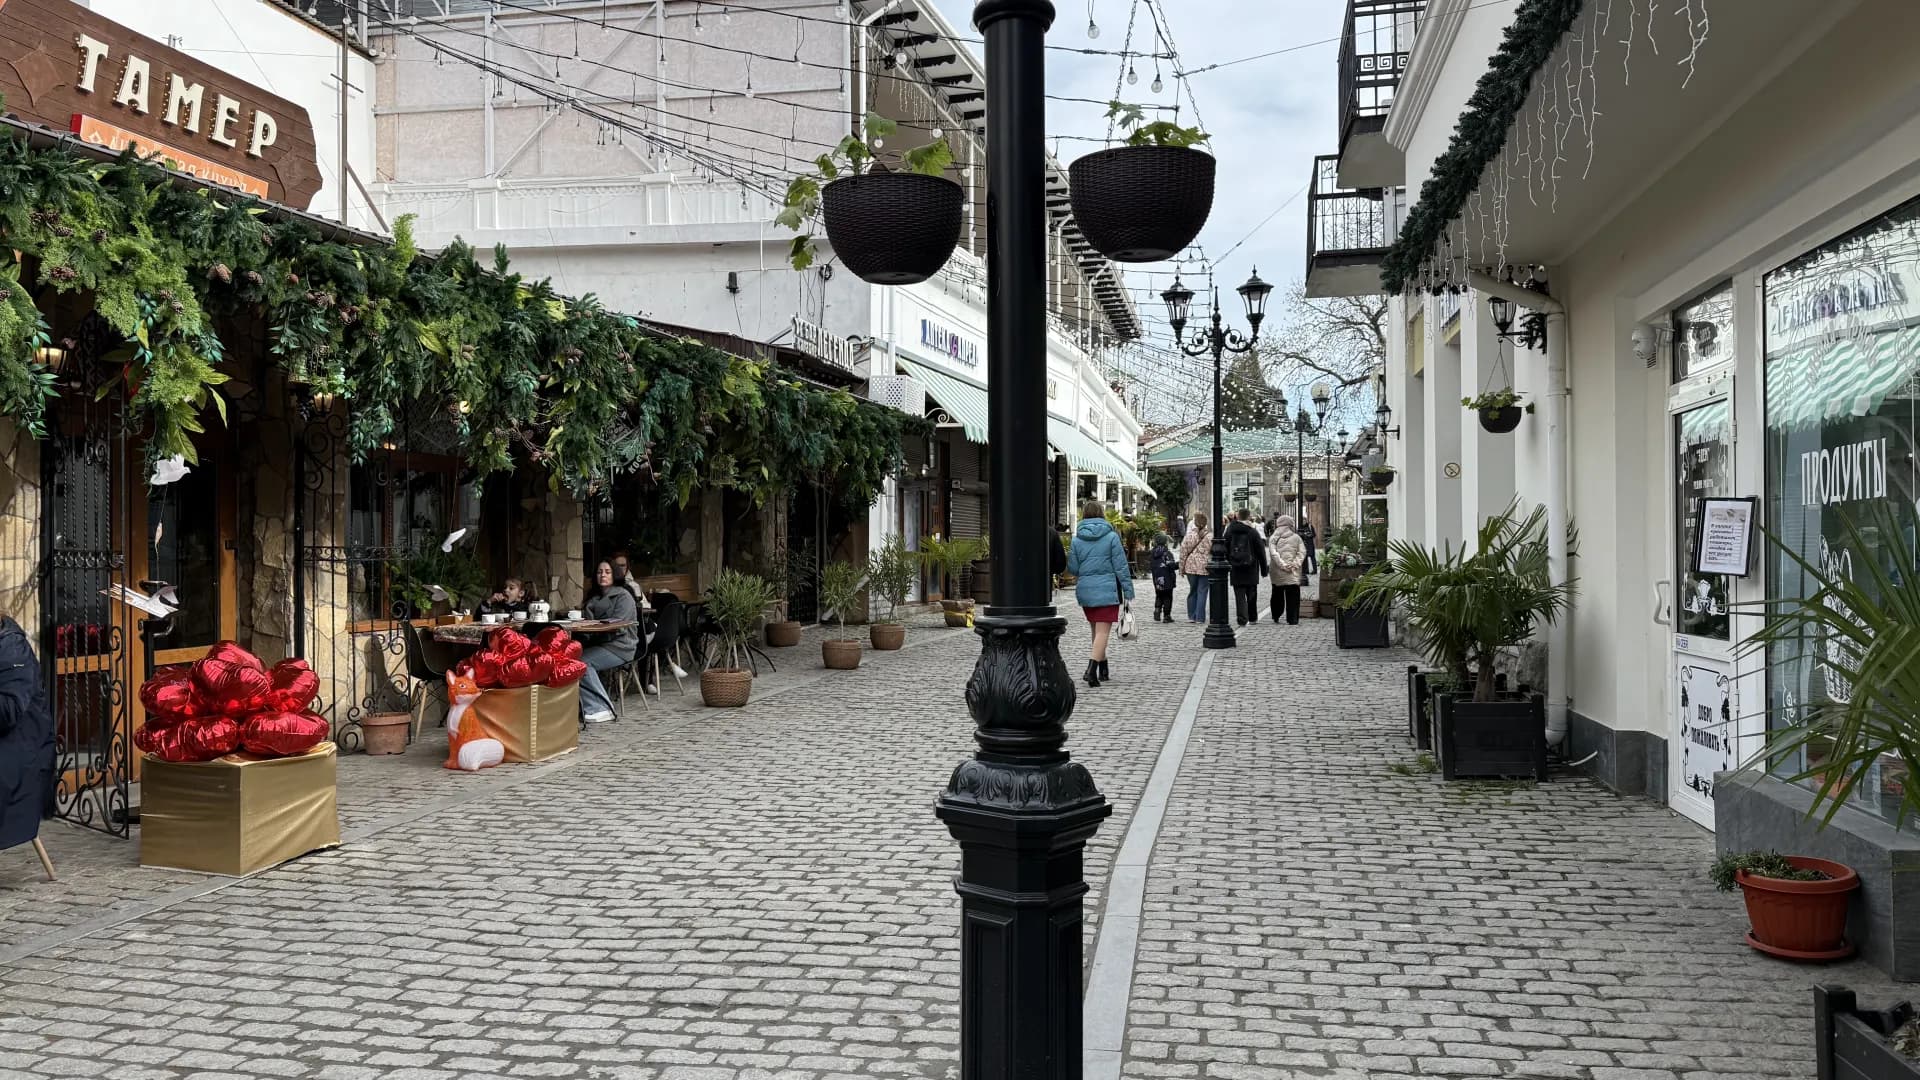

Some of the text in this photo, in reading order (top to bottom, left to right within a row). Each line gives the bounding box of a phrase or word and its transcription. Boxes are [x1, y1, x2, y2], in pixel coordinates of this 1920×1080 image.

[74, 32, 278, 158] ТАМЕР
[1800, 437, 1887, 507] ПРОДУКТЫ
[1697, 703, 1713, 723] ДОБРО
